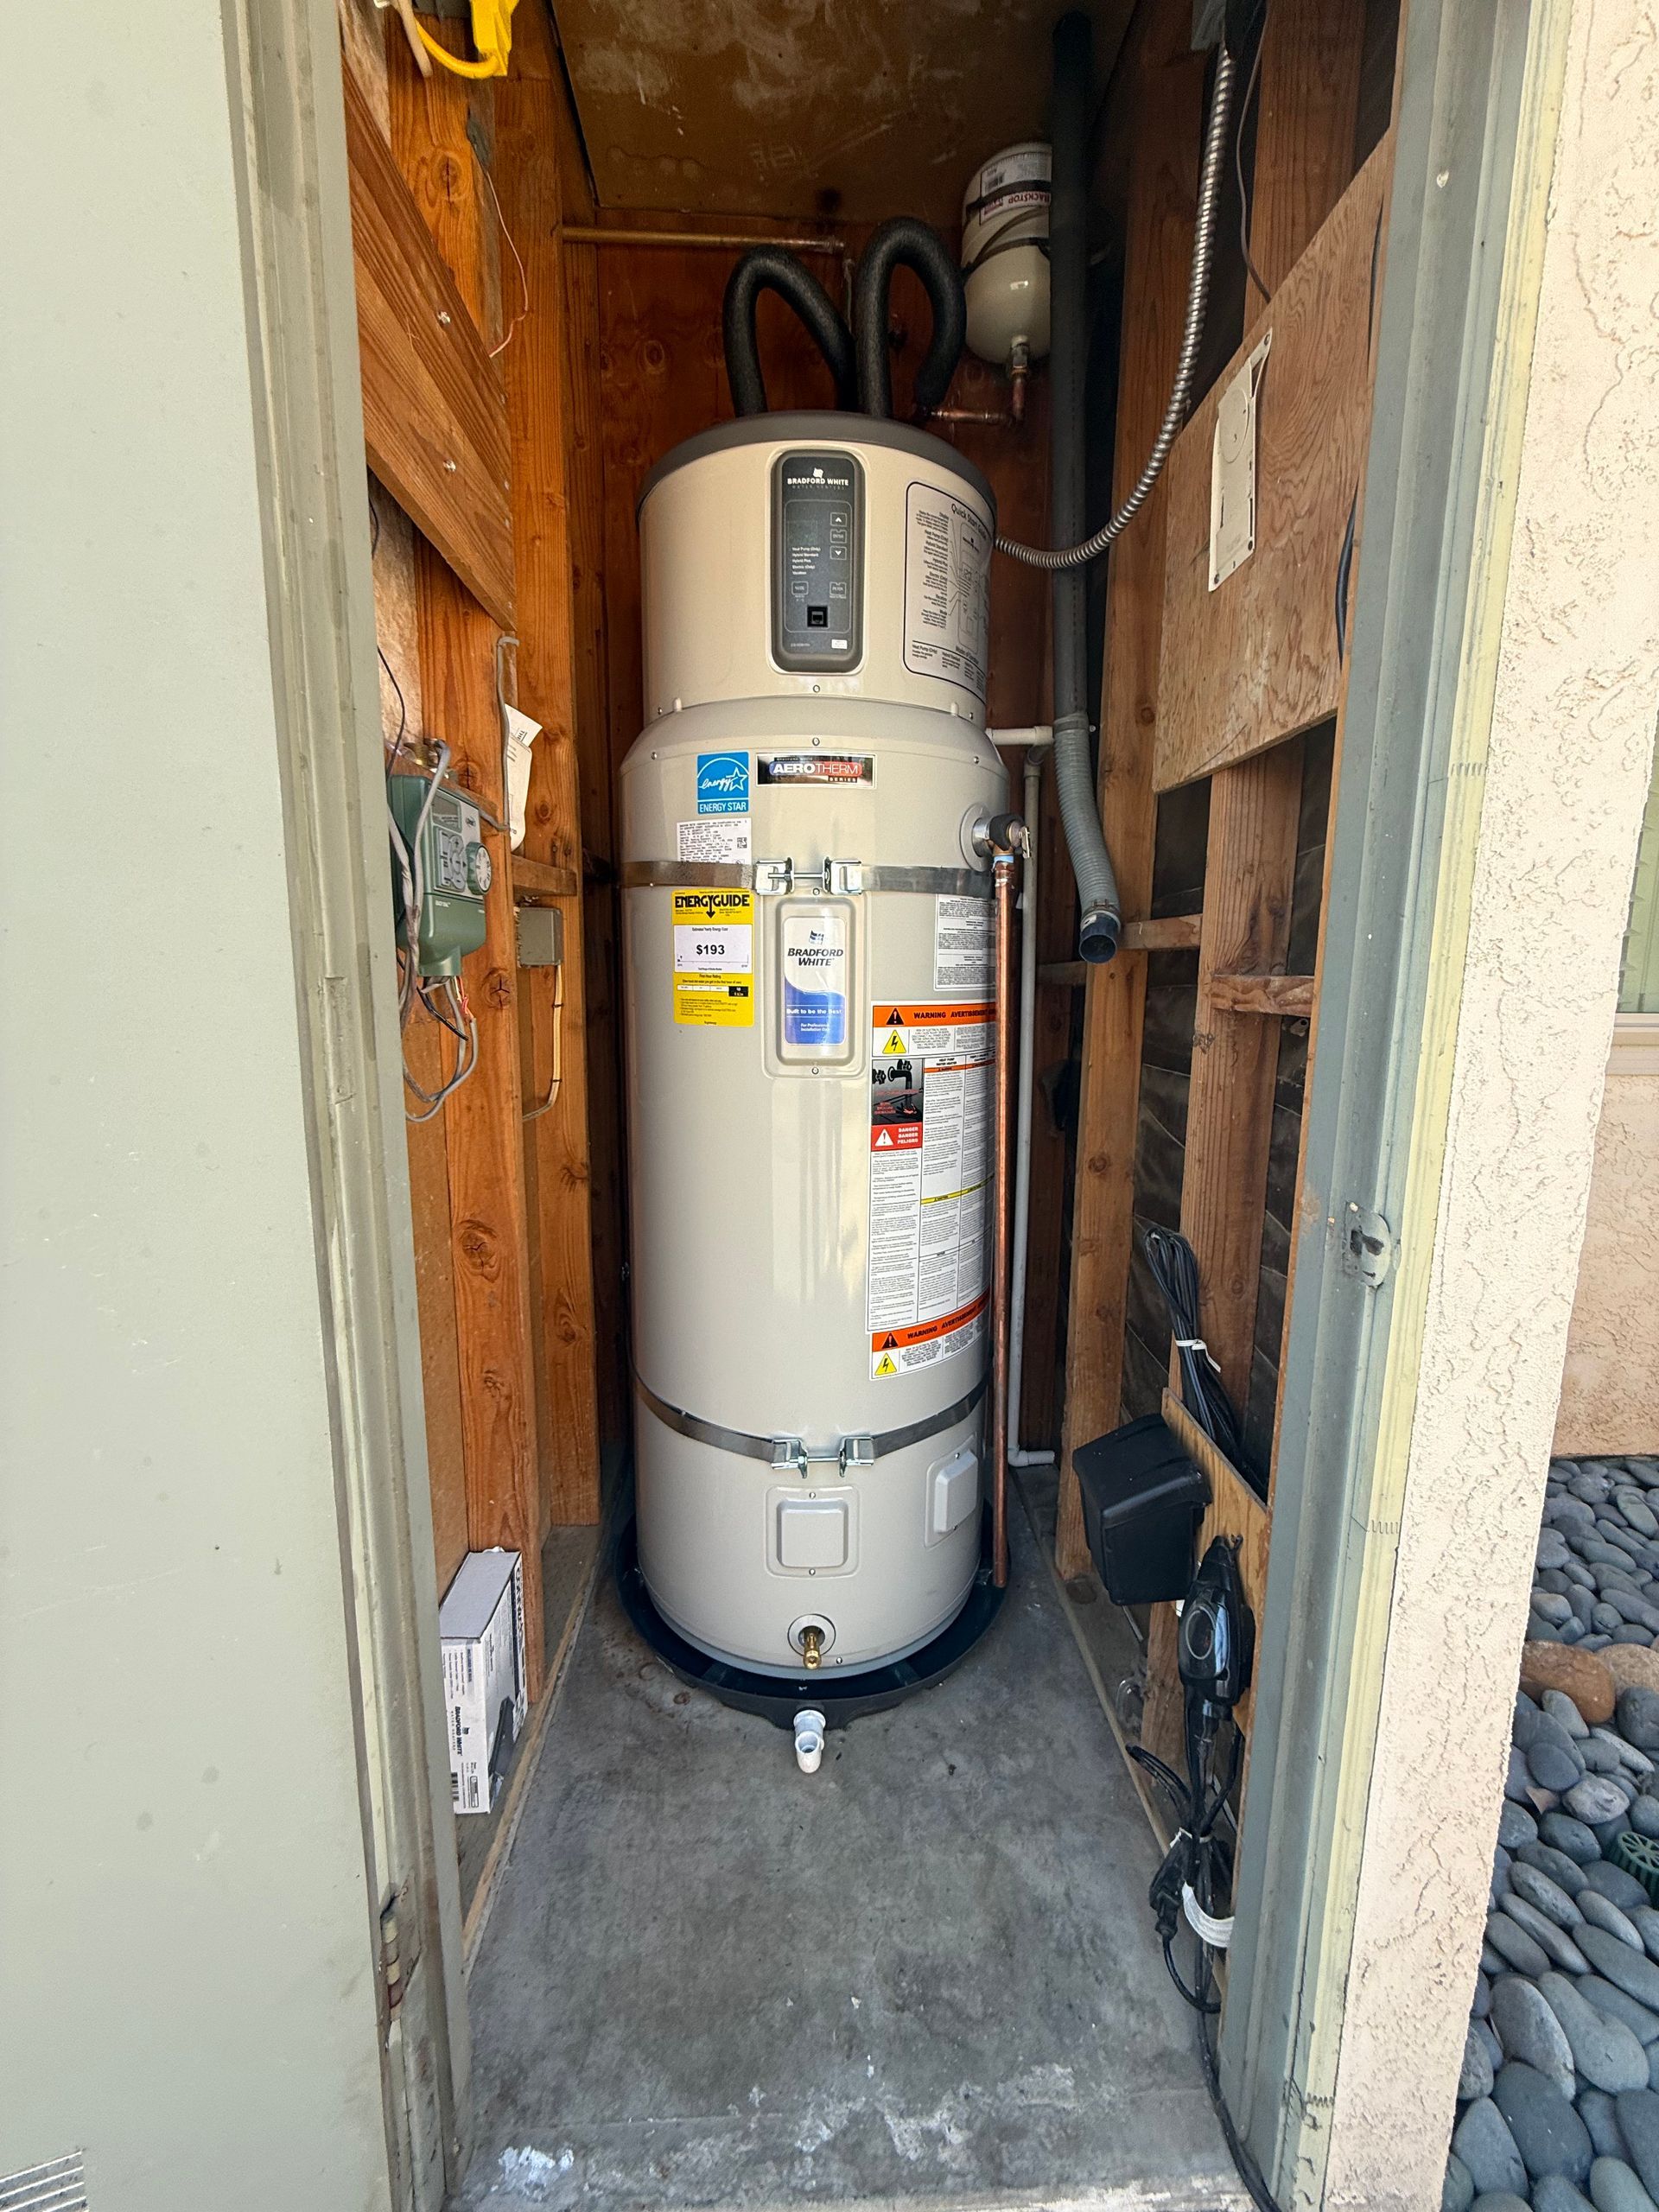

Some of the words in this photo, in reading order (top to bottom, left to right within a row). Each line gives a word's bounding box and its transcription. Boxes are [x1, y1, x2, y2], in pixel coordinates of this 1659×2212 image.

[773, 763, 858, 774] AEROTHERM
[699, 777, 734, 791] energy
[700, 803, 726, 812] ENERGY
[728, 802, 747, 811] STAR
[675, 894, 750, 908] ENERGYGUIDE
[696, 944, 725, 956] $193
[787, 948, 843, 957] BRADFORD
[798, 957, 832, 966] WHITE
[907, 1325, 938, 1339] WARNING
